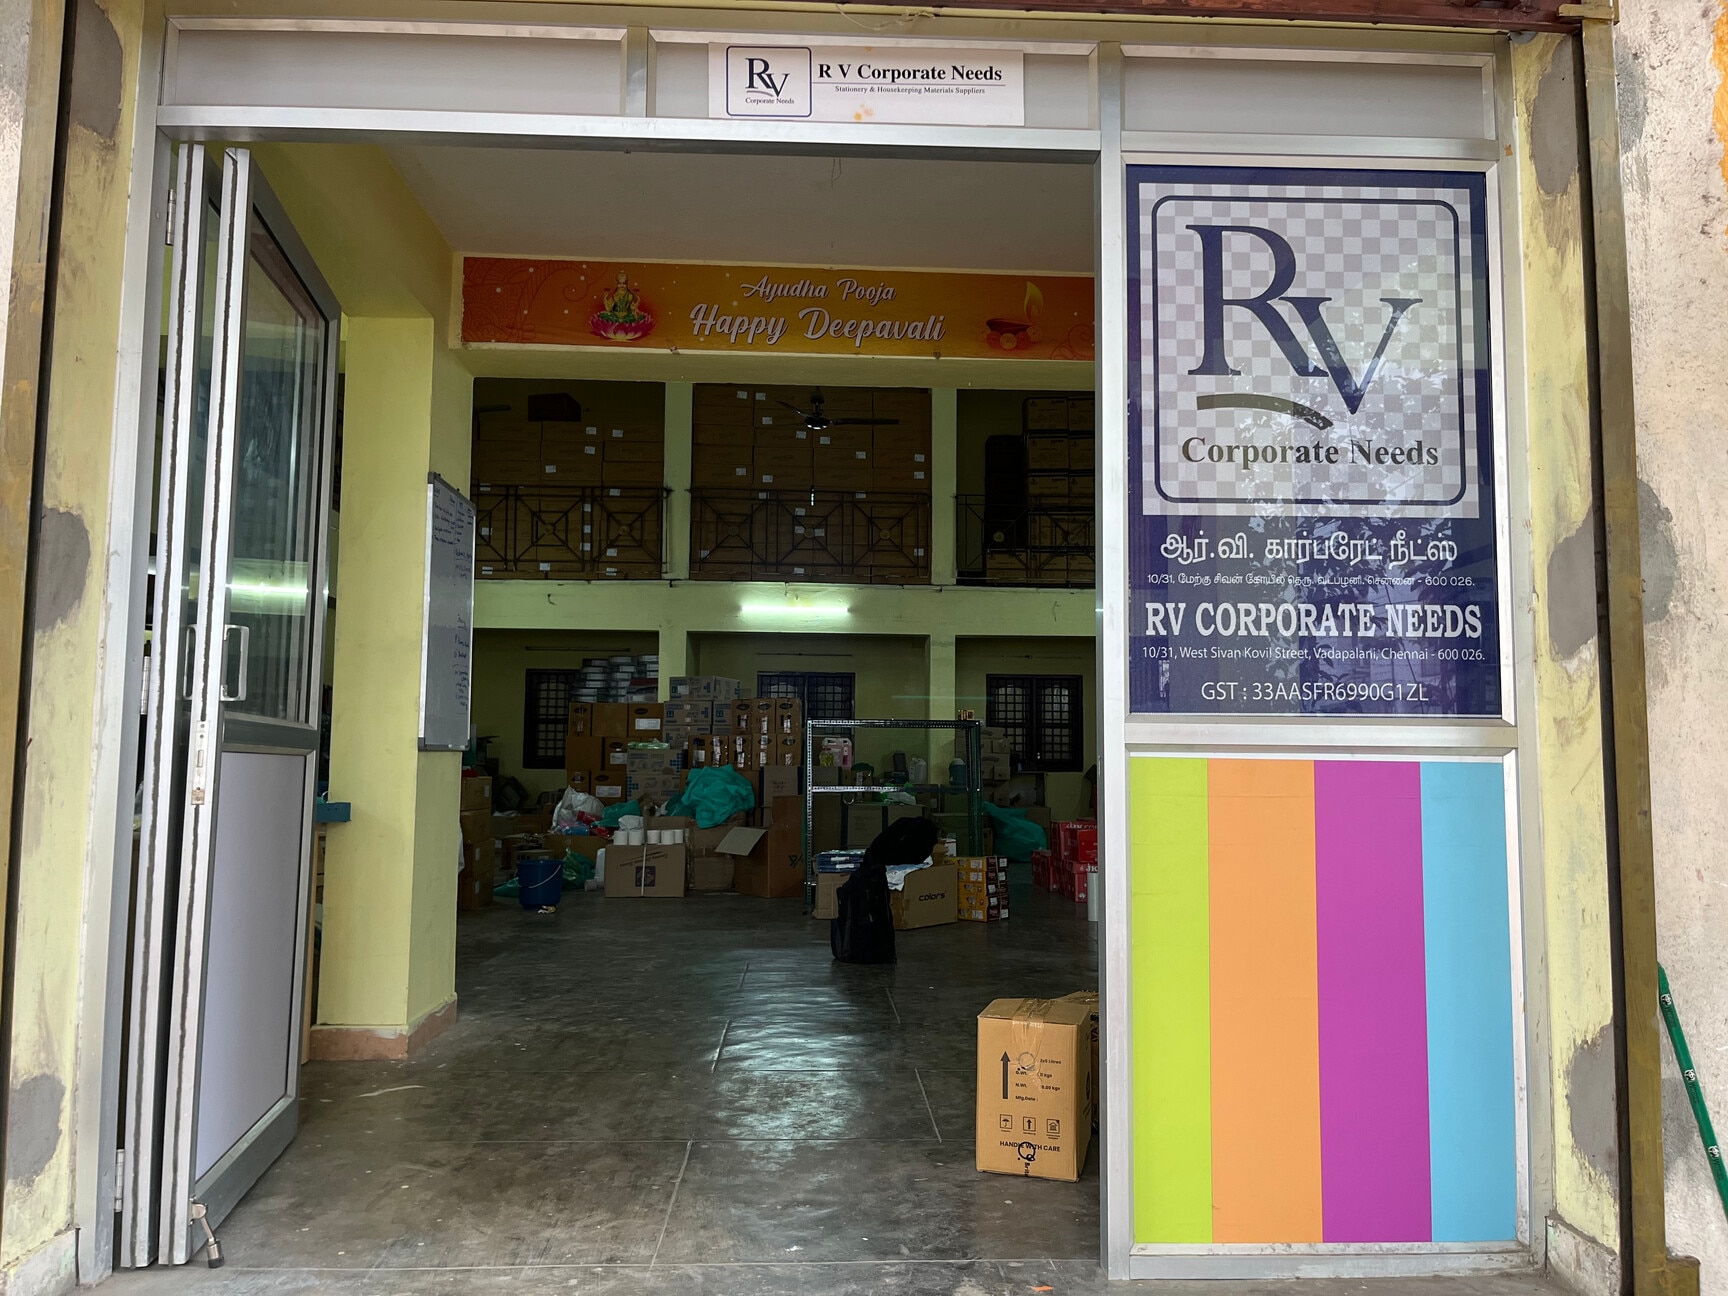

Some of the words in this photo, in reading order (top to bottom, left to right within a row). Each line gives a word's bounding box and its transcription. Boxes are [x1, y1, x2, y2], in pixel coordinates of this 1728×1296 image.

[745, 57, 790, 97] RV
[818, 63, 832, 78] R
[838, 64, 852, 79] V
[857, 64, 946, 82] Corporate
[951, 65, 1003, 81] Needs
[745, 96, 775, 106] Corporate
[834, 85, 868, 94] Stationery
[869, 86, 875, 94] &
[877, 86, 922, 95] Housekeeping
[955, 87, 986, 96] Suppliers
[740, 275, 830, 303] Ayudha
[836, 278, 897, 306] Pooja
[690, 303, 788, 345] Happy
[798, 307, 946, 348] Deepavali
[1185, 224, 1424, 415] RV
[1182, 436, 1339, 470] Corporate
[1351, 439, 1438, 466] Needs
[1178, 572, 1212, 587] மேற்கு
[1214, 572, 1244, 584] சிவன்
[1425, 576, 1448, 586] 600
[1145, 602, 1186, 635] RV
[1196, 603, 1376, 638] CORPORATE
[1384, 604, 1482, 638] NEEDS
[1142, 646, 1178, 661] 10/31,
[1180, 647, 1208, 659] West
[1210, 646, 1242, 659] Sivan
[1244, 646, 1272, 659] Kovil
[1275, 647, 1312, 661] Street,
[1312, 646, 1380, 663] Vadapalani,
[1381, 648, 1428, 660] Chennai
[1438, 648, 1460, 660] 600
[1461, 648, 1486, 660] 026.
[1201, 681, 1239, 700] GST
[1252, 682, 1430, 702] 33AASFR6990G1ZL
